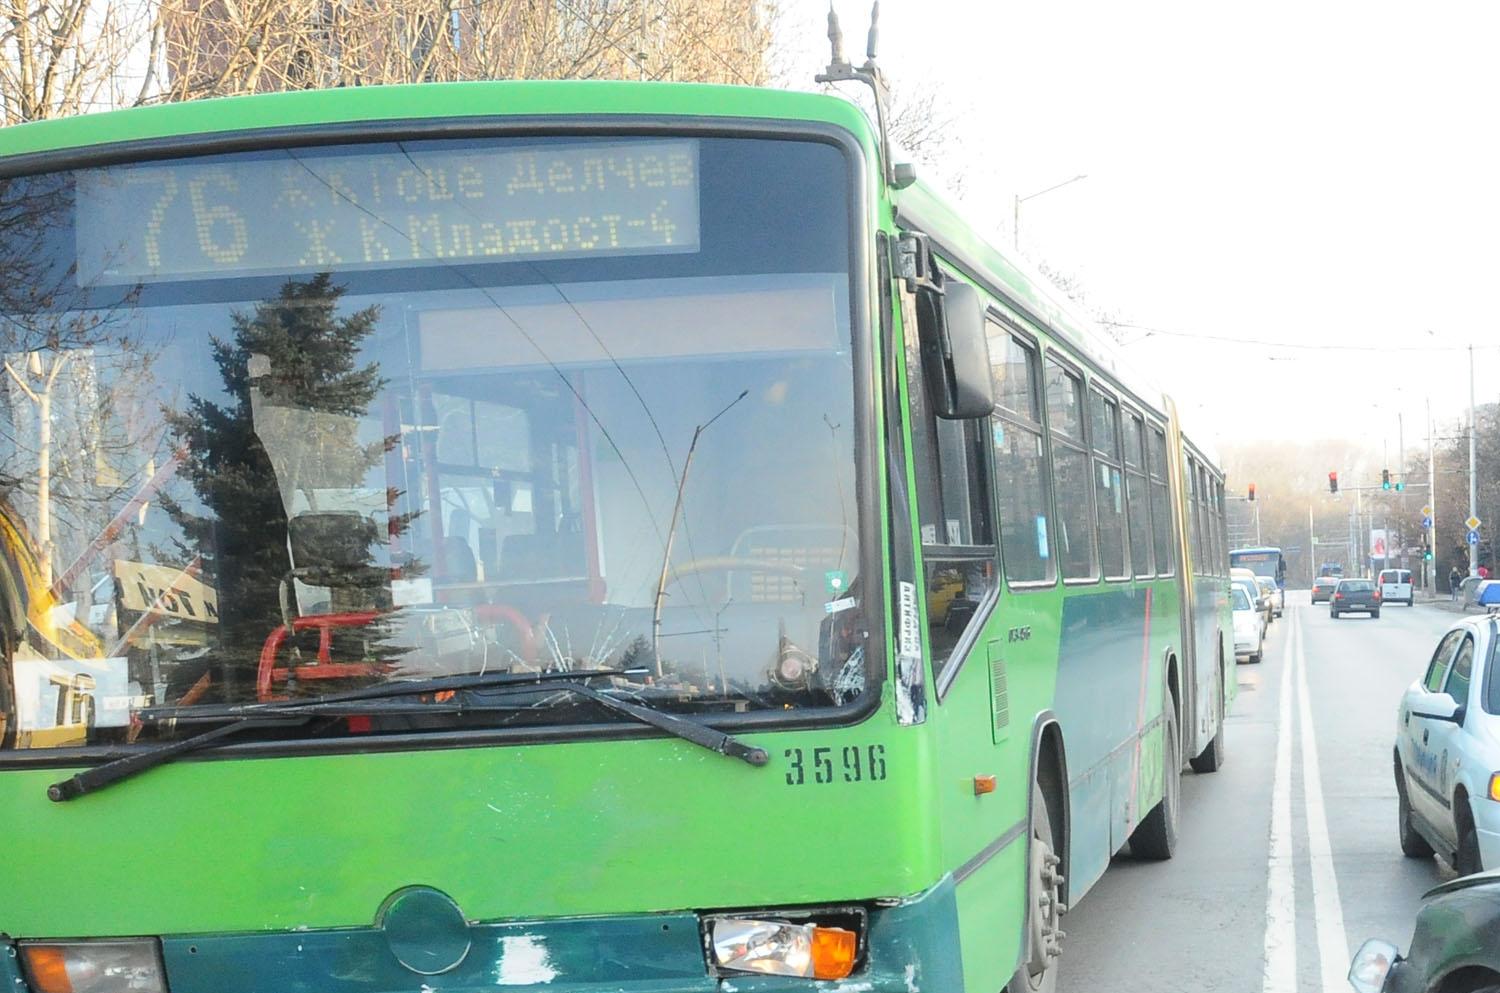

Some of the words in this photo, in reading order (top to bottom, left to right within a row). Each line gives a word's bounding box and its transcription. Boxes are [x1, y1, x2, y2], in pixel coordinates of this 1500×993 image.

[506, 152, 695, 196] Делчев
[126, 167, 249, 266] 76
[408, 198, 677, 259] Младост-4
[784, 744, 887, 786] 3596
